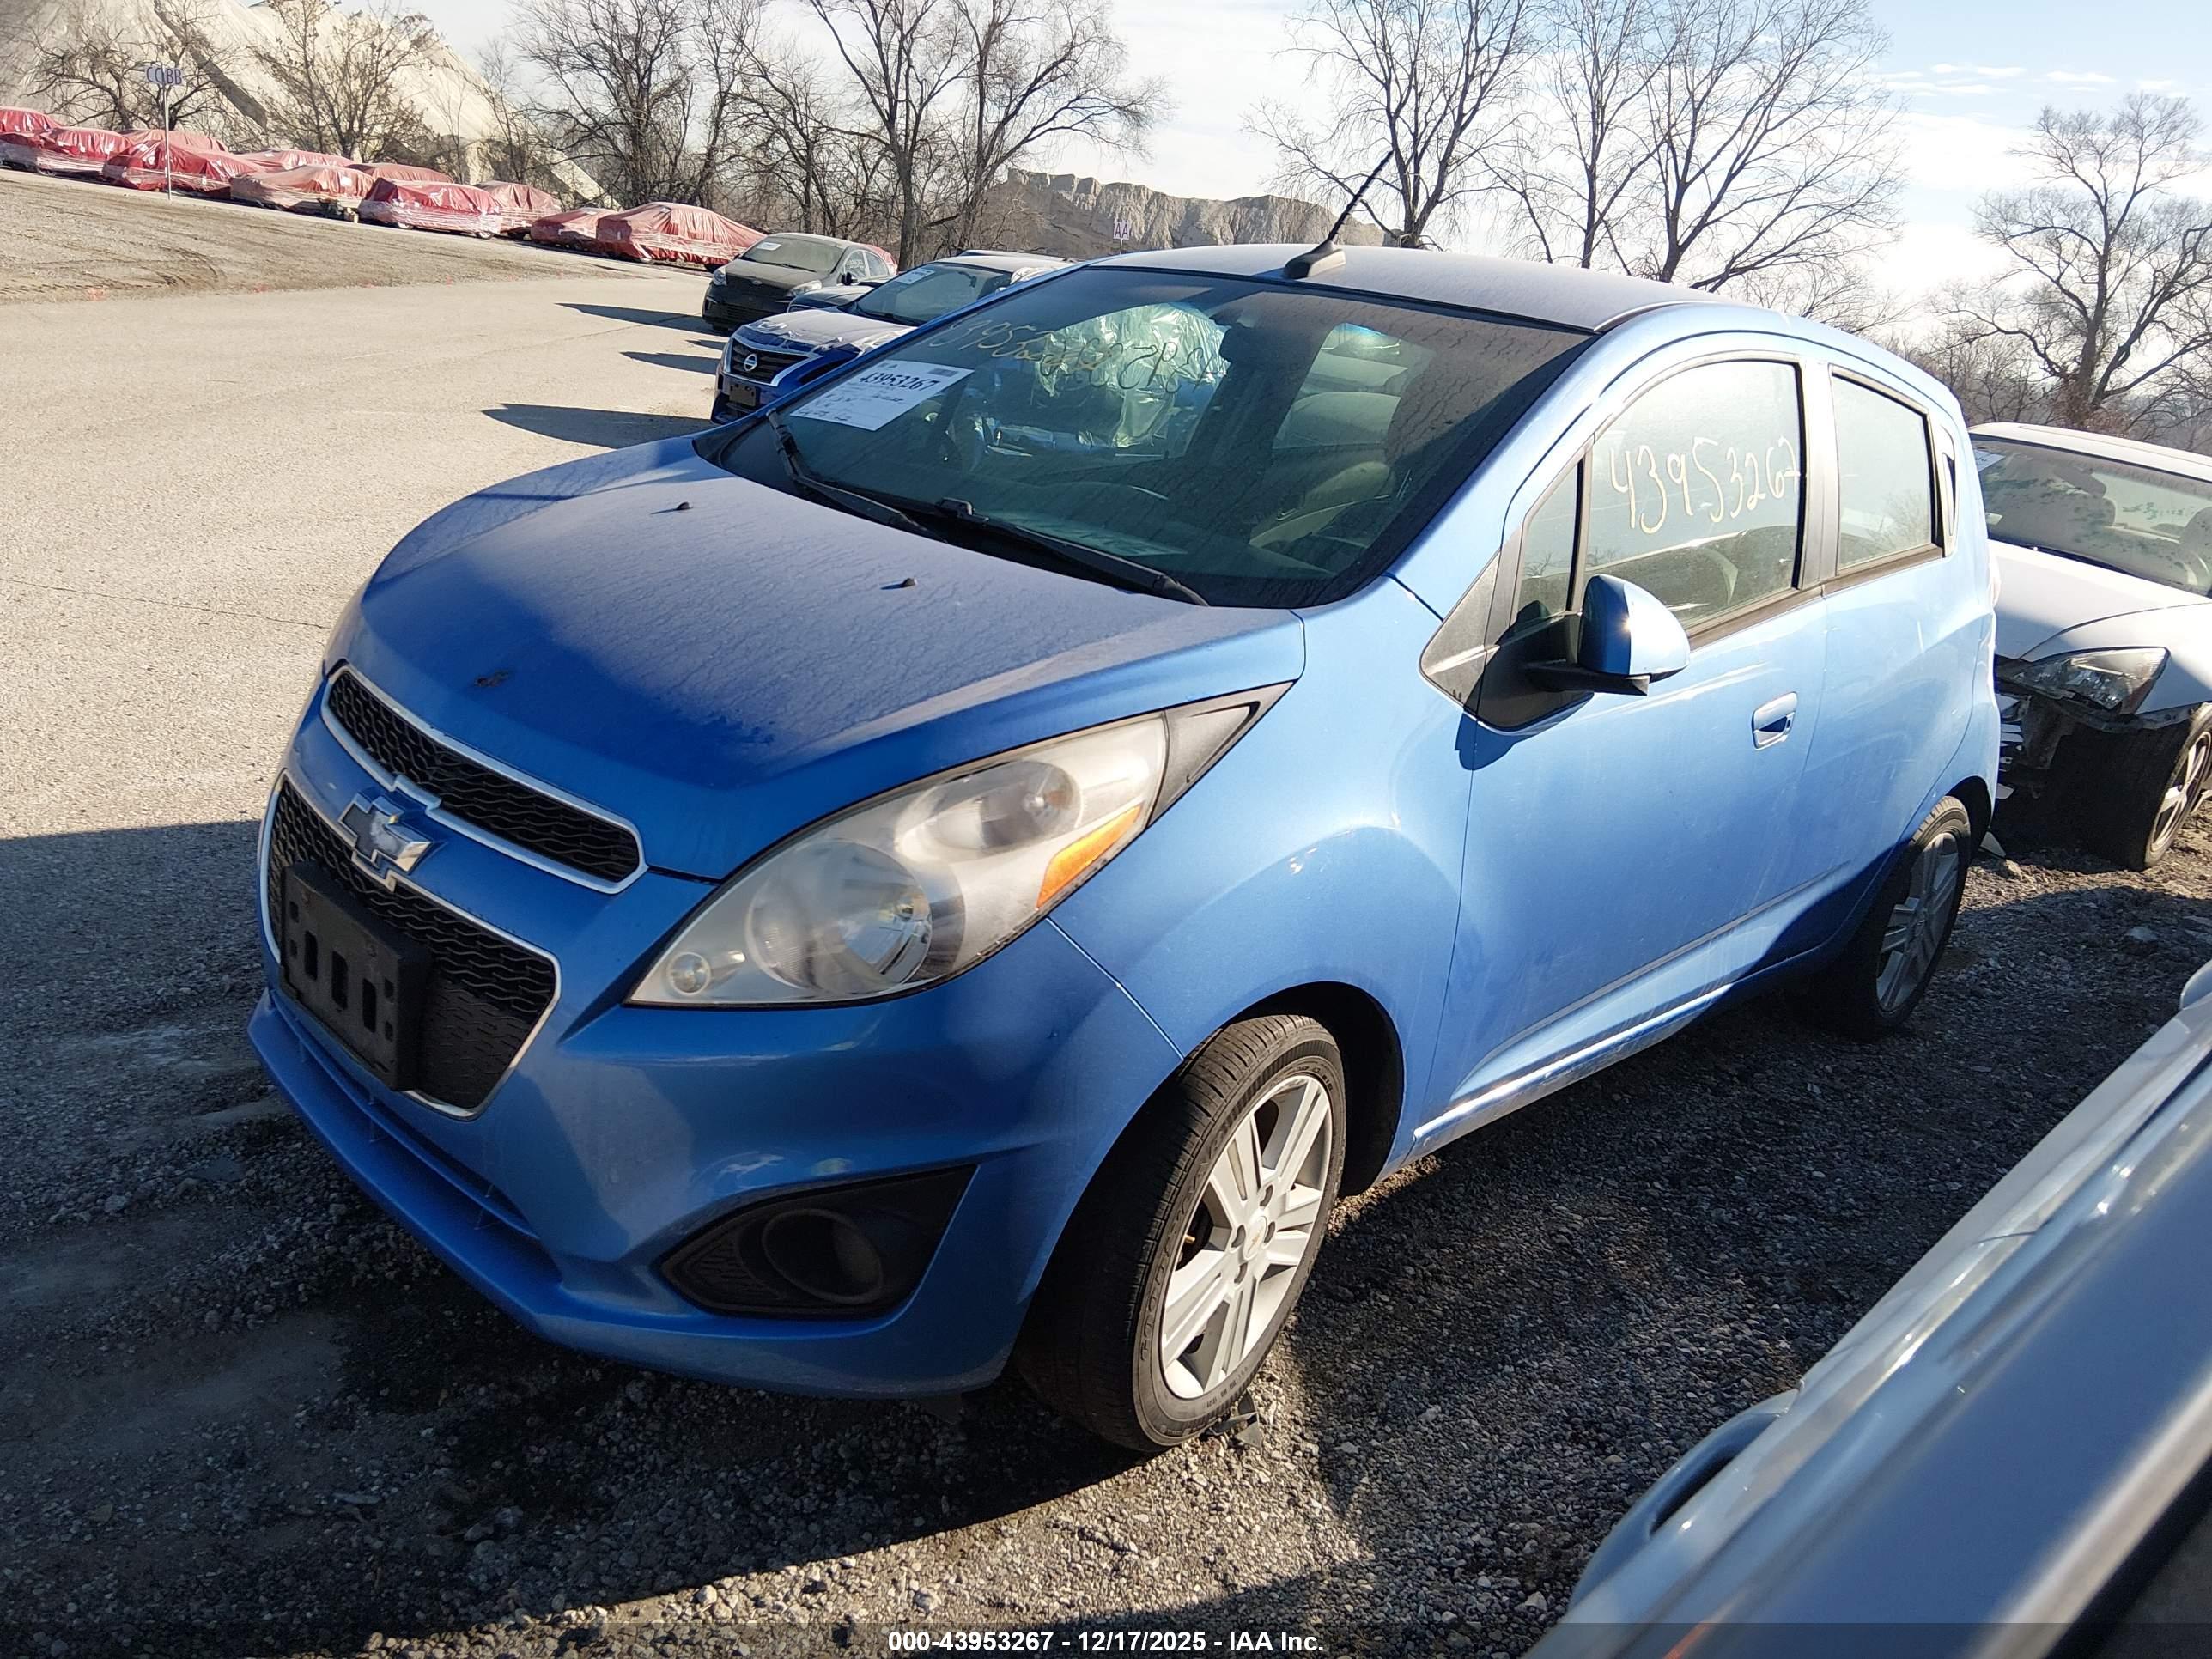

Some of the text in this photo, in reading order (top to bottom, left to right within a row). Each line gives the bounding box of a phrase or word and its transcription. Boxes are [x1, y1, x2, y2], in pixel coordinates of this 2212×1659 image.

[1114, 222, 1129, 239] AA
[859, 372, 943, 392] 43953267
[1609, 434, 1801, 535] 43953267
